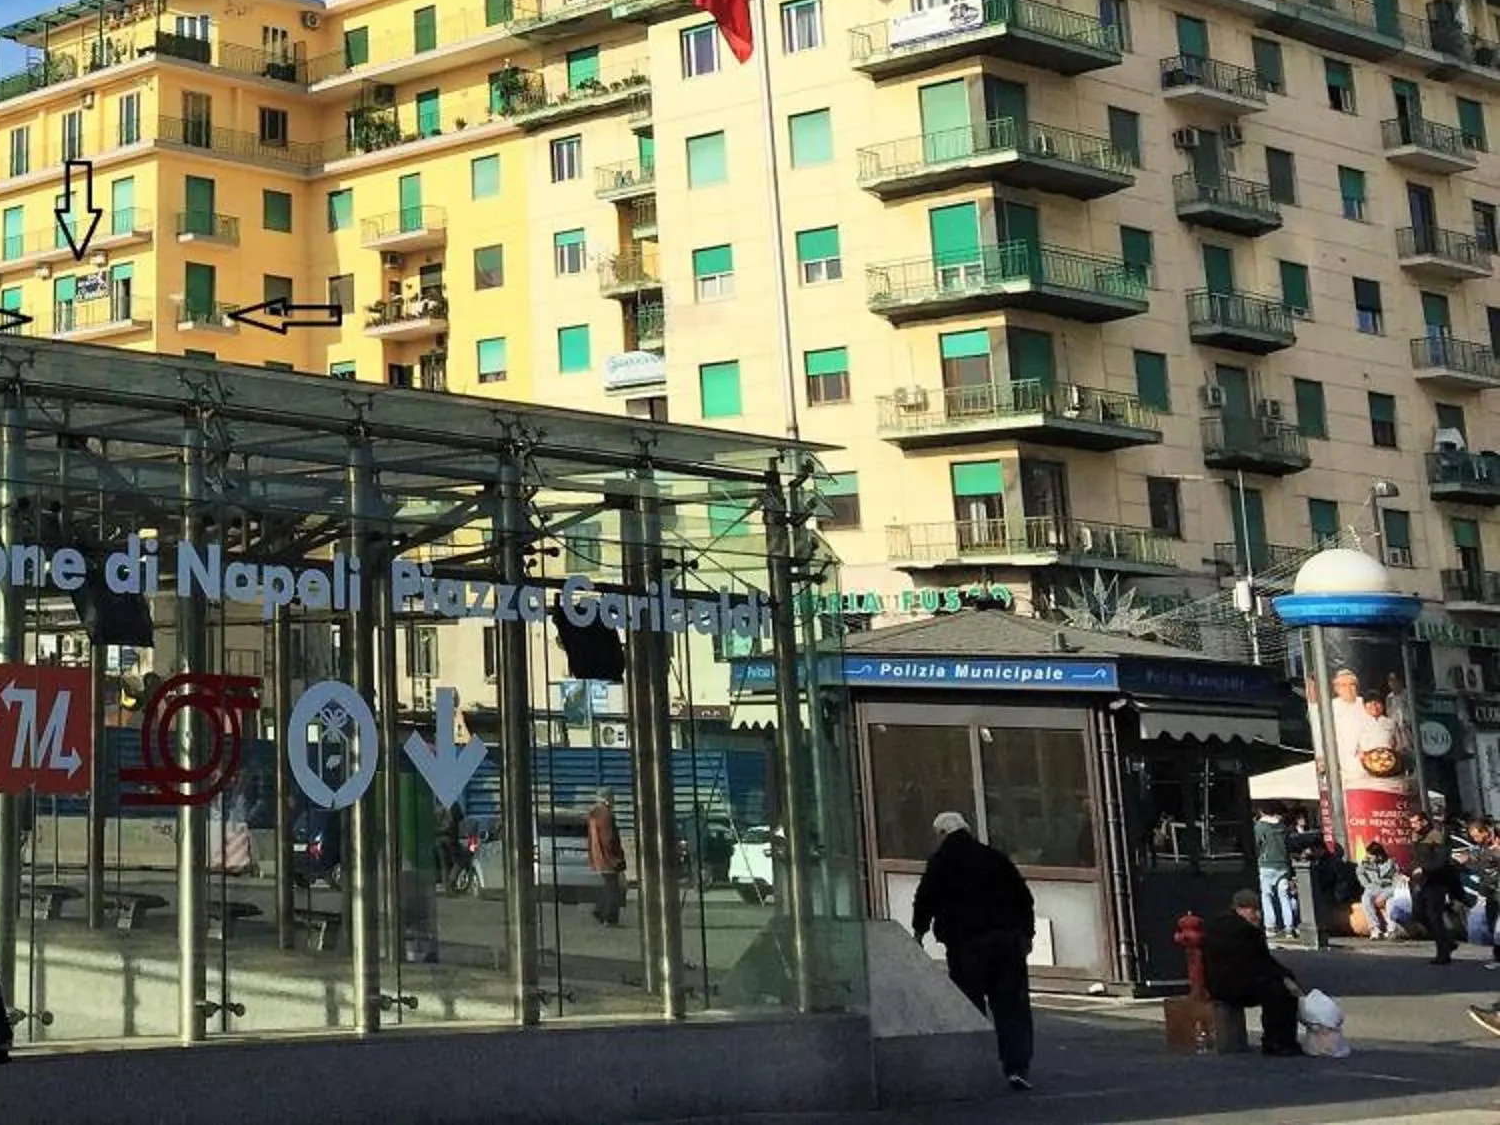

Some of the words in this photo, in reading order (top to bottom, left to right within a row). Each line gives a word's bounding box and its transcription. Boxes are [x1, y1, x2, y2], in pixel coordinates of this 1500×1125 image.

[106, 534, 158, 595] di
[178, 541, 361, 621] Napoli
[391, 556, 546, 622] Piazza
[562, 575, 772, 637] Garibaldi
[880, 662, 946, 678] Polizia
[955, 664, 1063, 682] Municipale
